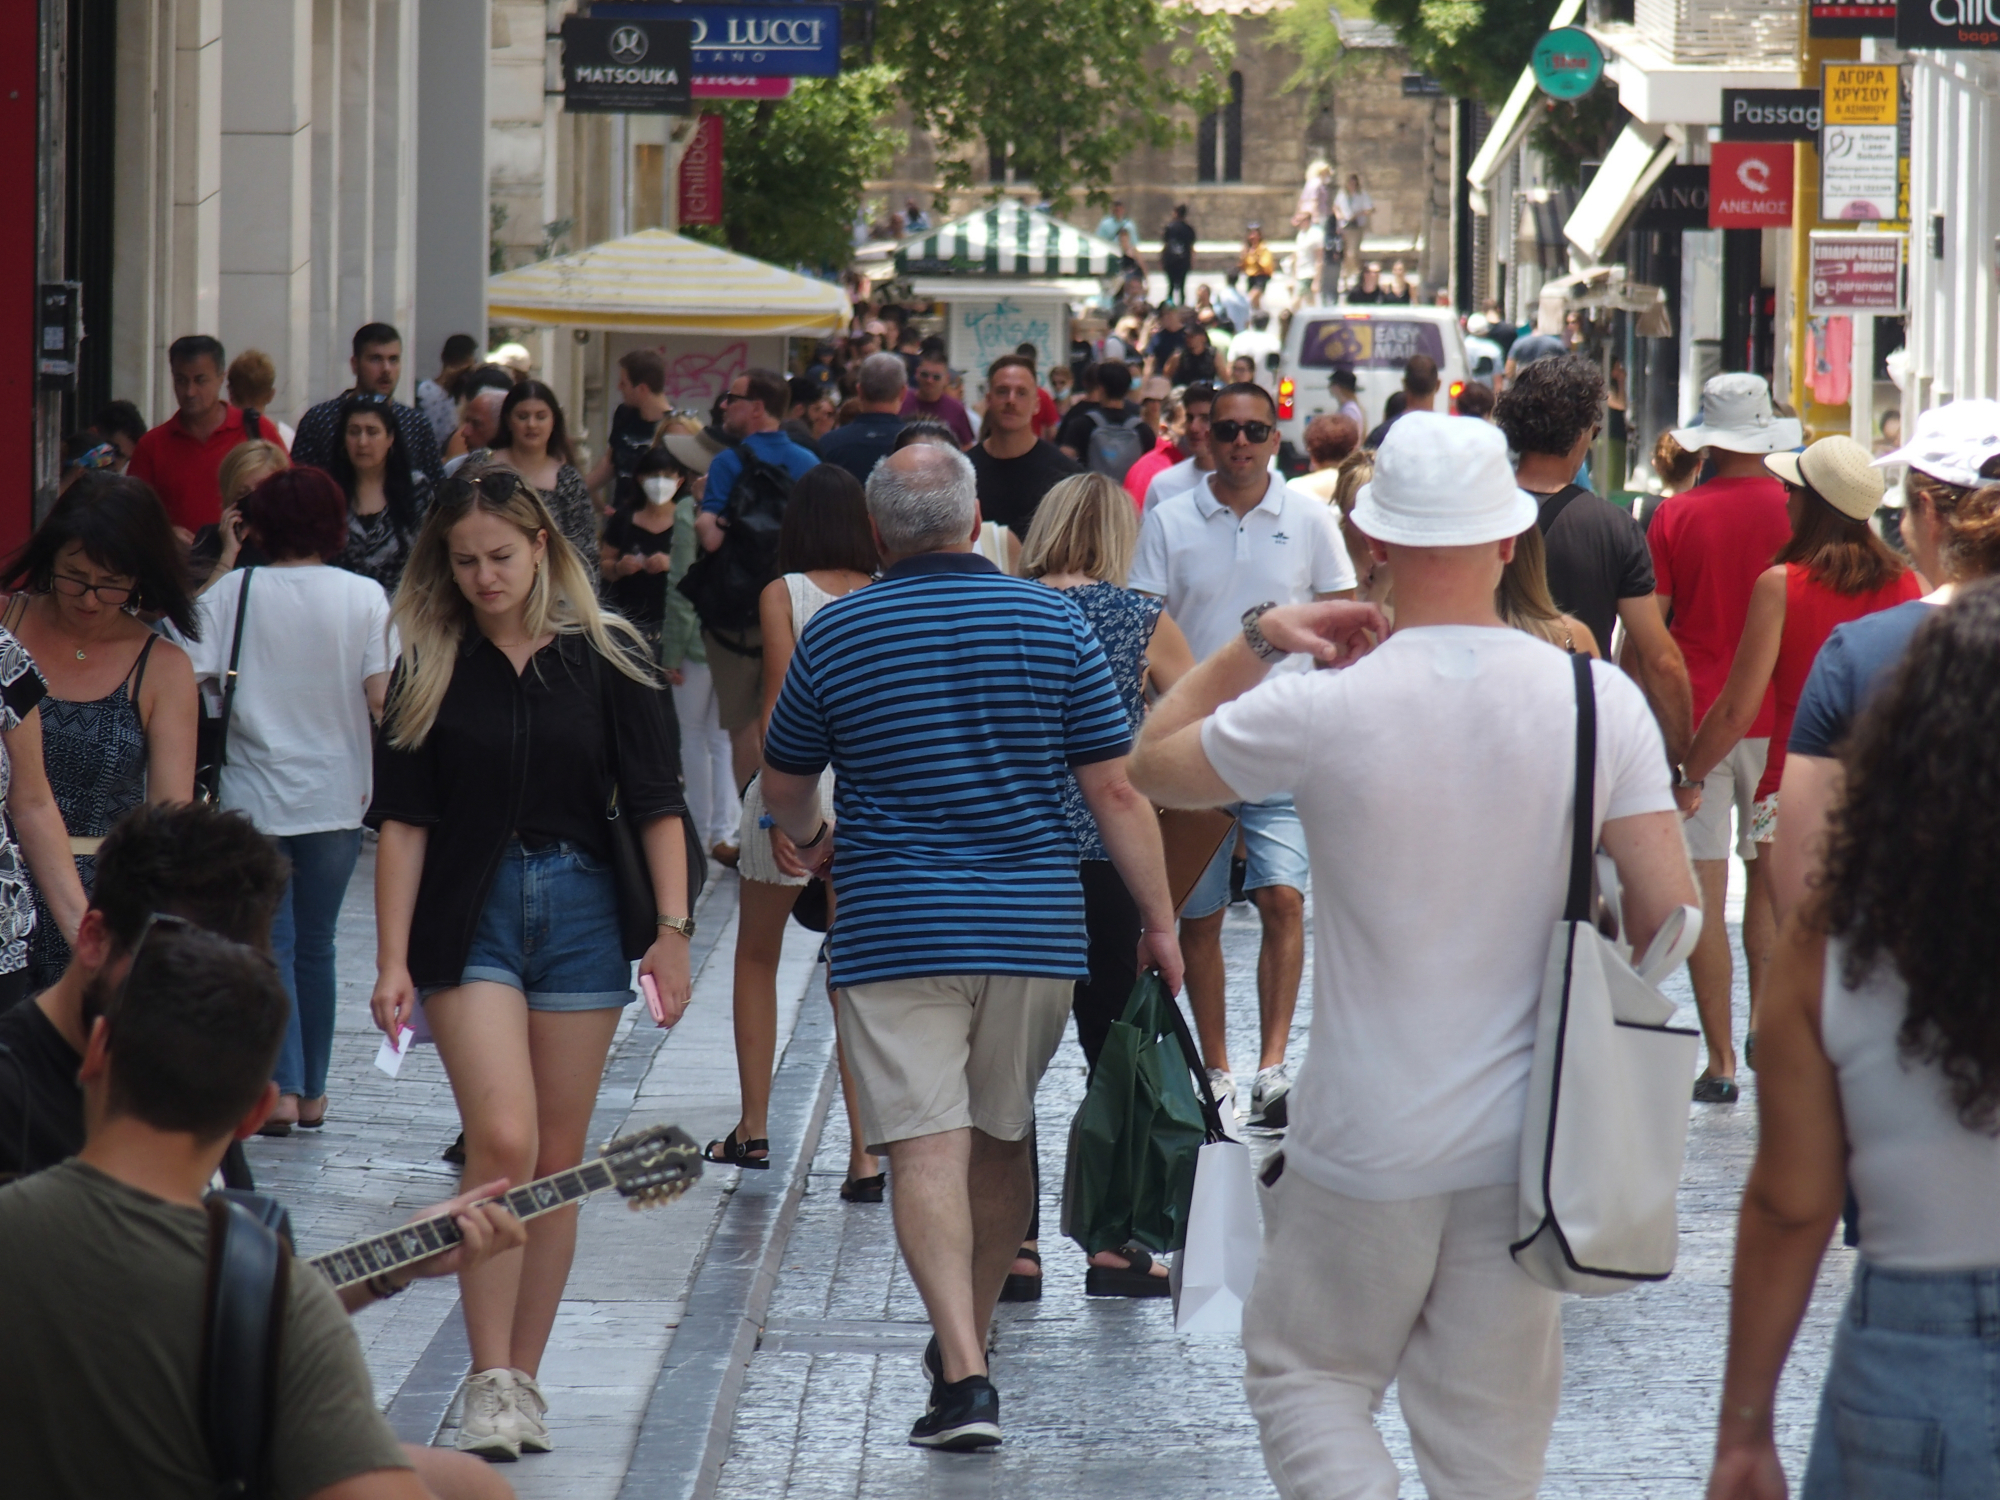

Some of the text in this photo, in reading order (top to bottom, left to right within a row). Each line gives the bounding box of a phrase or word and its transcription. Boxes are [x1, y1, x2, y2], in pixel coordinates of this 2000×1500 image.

[727, 19, 821, 45] LUCCI
[1958, 29, 1999, 45] bags
[575, 67, 680, 86] MATSOUKA
[1838, 69, 1885, 85] ΑΓΟΡΑ
[1833, 87, 1890, 102] ΧΡΥΣΟΥ
[1717, 199, 1788, 215] ΑΝΕΜΟΣ
[1374, 325, 1421, 343] EASY
[1373, 343, 1417, 359] MAIL
